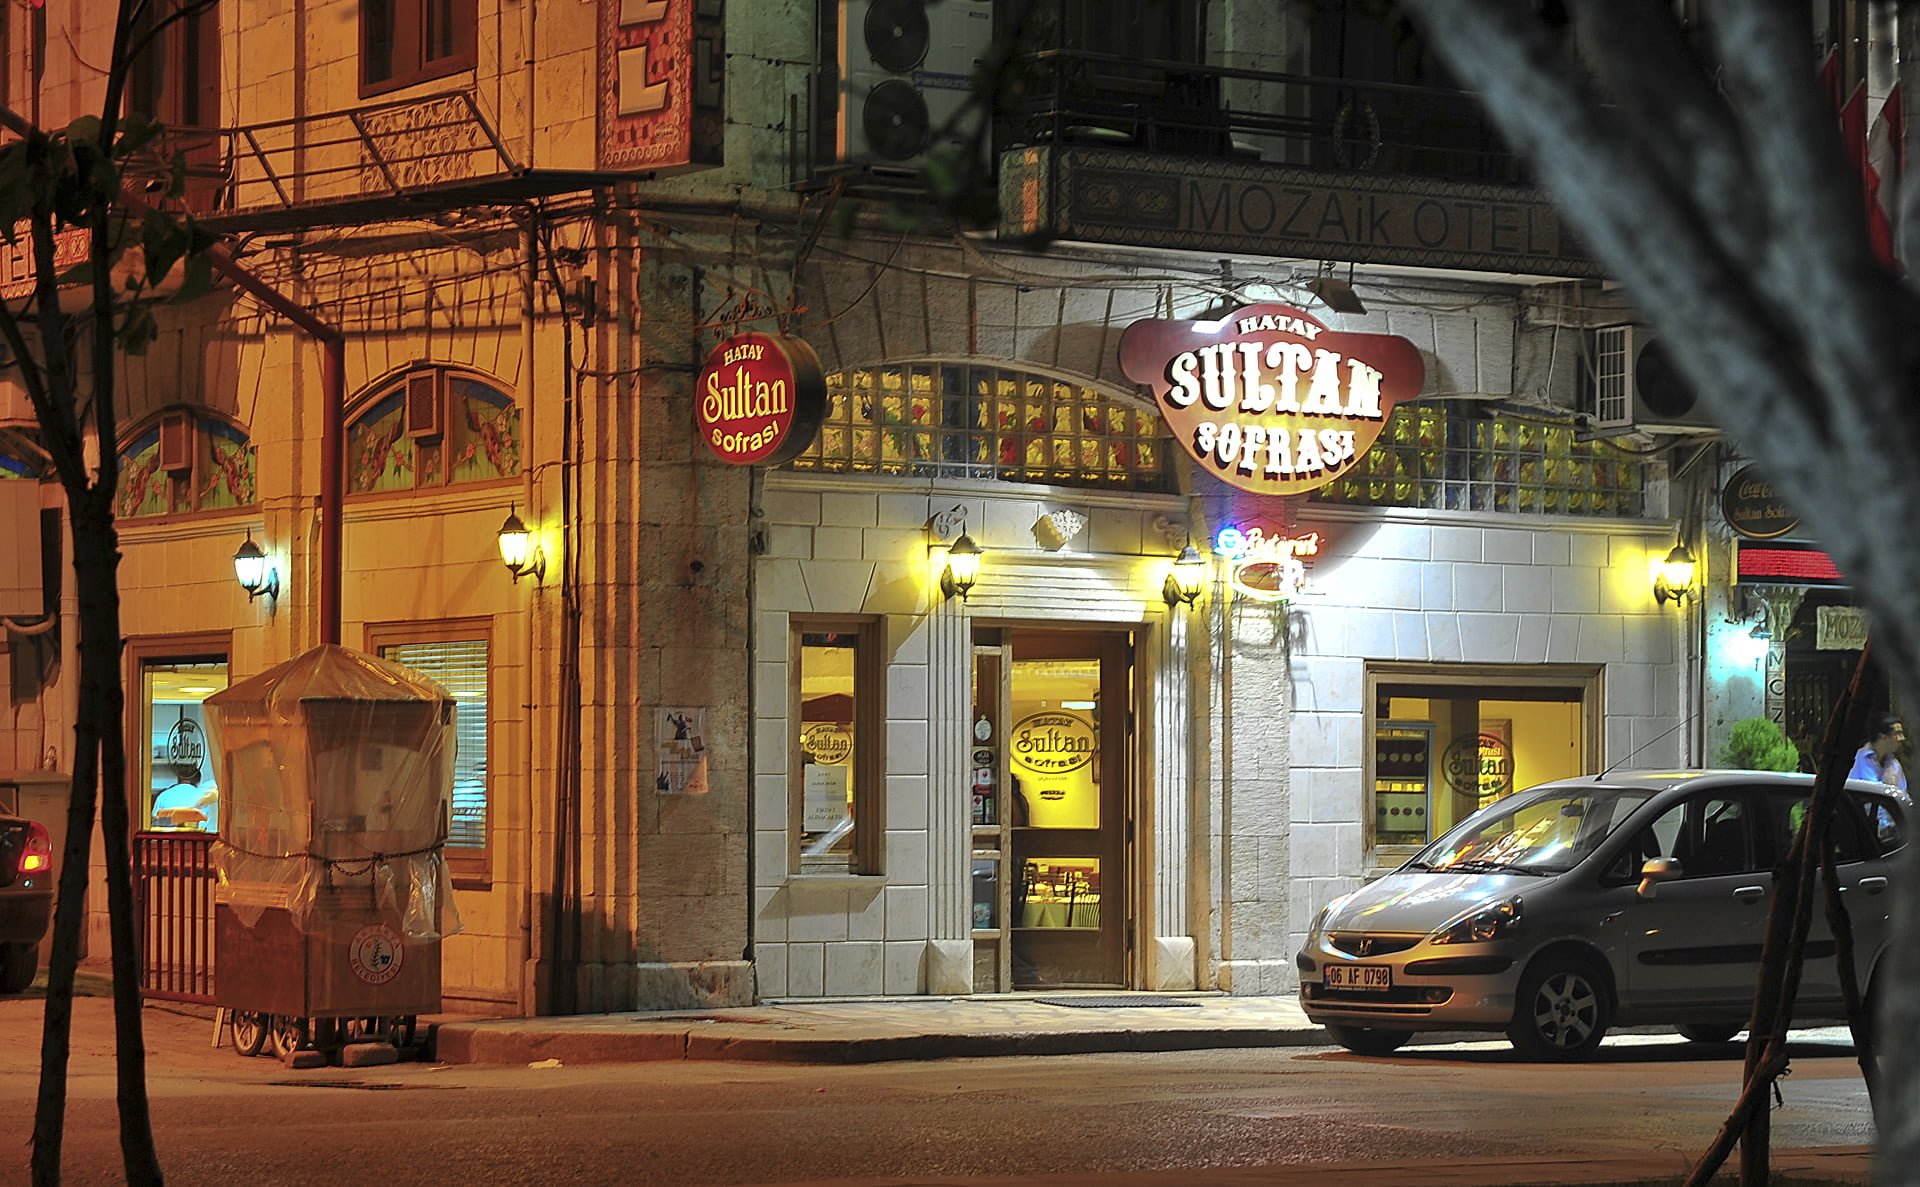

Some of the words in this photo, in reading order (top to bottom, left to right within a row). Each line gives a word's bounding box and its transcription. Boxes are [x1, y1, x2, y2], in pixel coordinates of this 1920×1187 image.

[1413, 198, 1551, 256] OTEL
[1238, 315, 1323, 341] HATAY
[724, 344, 764, 366] HATAY
[1166, 341, 1384, 420] SULTAN
[702, 365, 788, 424] Sultan
[171, 734, 203, 759] Sultan
[807, 733, 848, 751] Sultan
[1016, 727, 1092, 753] Sultan
[1448, 745, 1510, 776] Sultan
[1330, 967, 1343, 984] 06
[1348, 967, 1360, 984] AF
[1364, 968, 1388, 985] 0798
